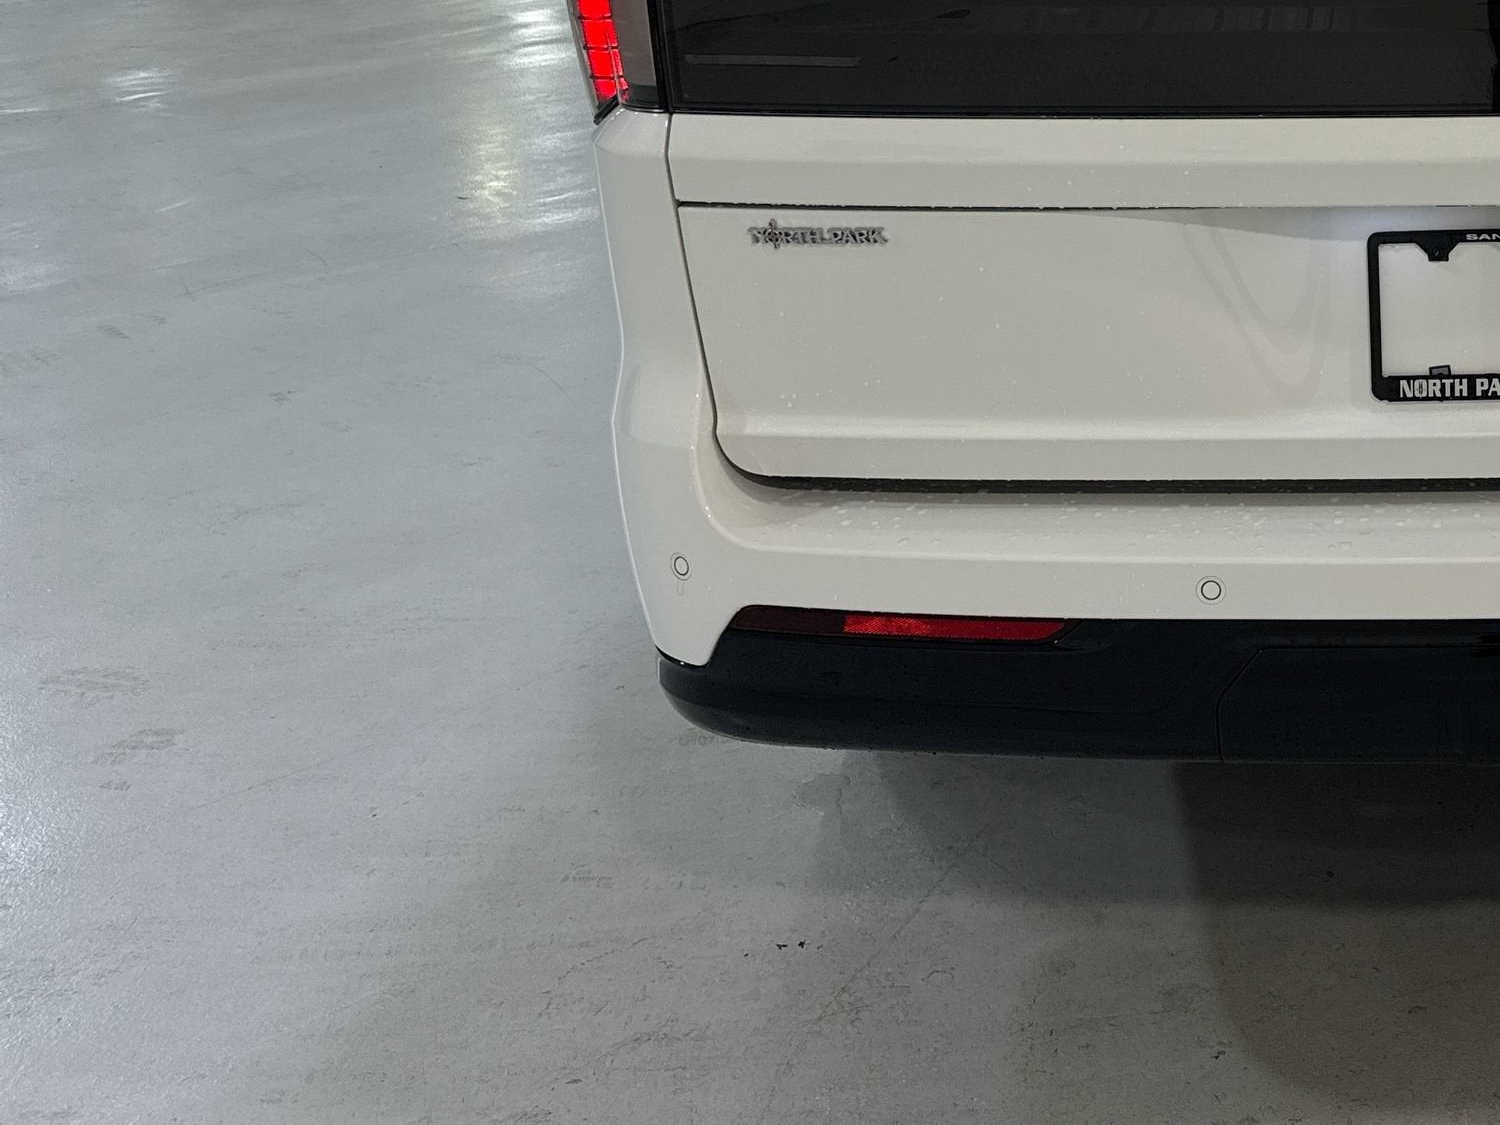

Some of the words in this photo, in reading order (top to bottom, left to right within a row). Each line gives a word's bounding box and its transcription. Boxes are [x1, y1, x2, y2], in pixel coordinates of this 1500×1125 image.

[748, 222, 823, 247] NORTH
[827, 226, 888, 245] PARK
[1399, 378, 1467, 398] NORTH
